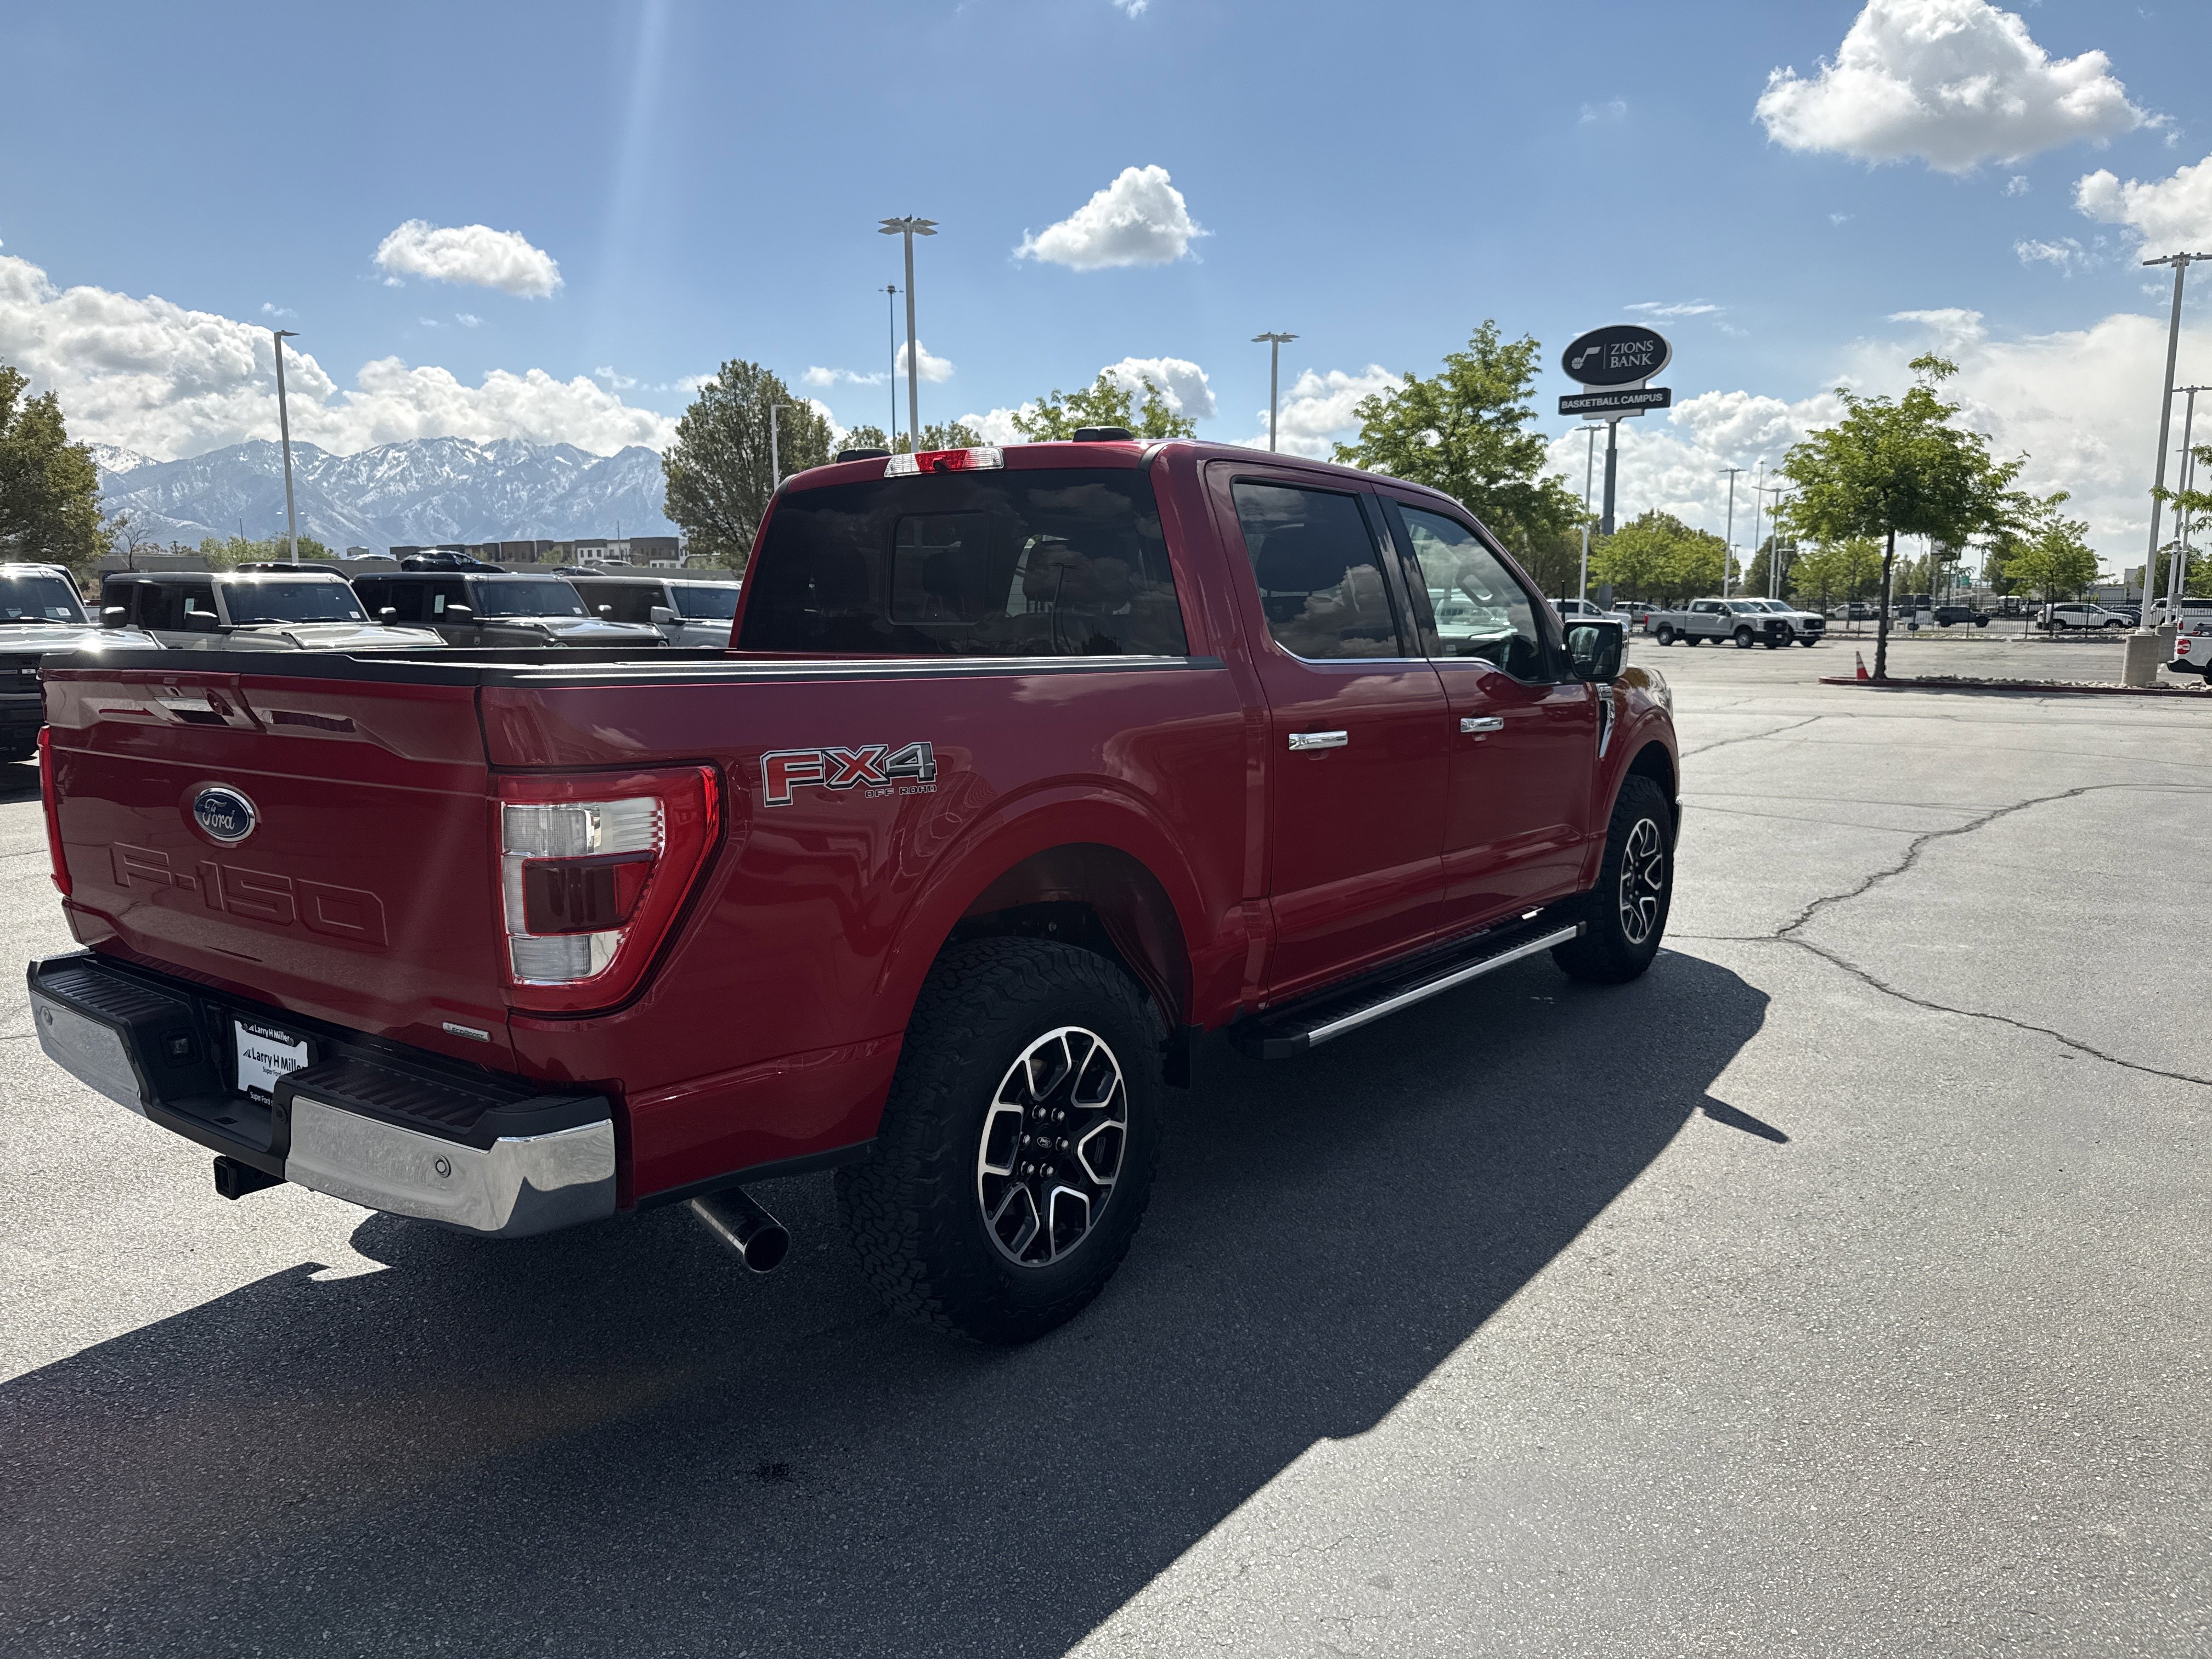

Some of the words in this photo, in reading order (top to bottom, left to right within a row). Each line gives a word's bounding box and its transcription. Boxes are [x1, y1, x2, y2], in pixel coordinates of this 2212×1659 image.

[1610, 340, 1654, 355] ZIONS
[1611, 353, 1654, 368] BANK
[1561, 397, 1621, 409] BASKETBALL
[1621, 393, 1663, 404] CAMPUS
[759, 741, 938, 808] FX4
[864, 788, 894, 799] OFF
[899, 785, 937, 795] ROAD
[202, 798, 235, 830] Ford
[109, 841, 389, 947] F-150
[254, 1024, 268, 1037] Larry
[268, 1028, 274, 1037] H
[273, 1030, 290, 1042] Miller
[252, 1047, 272, 1068] Larry
[273, 1054, 279, 1068] H
